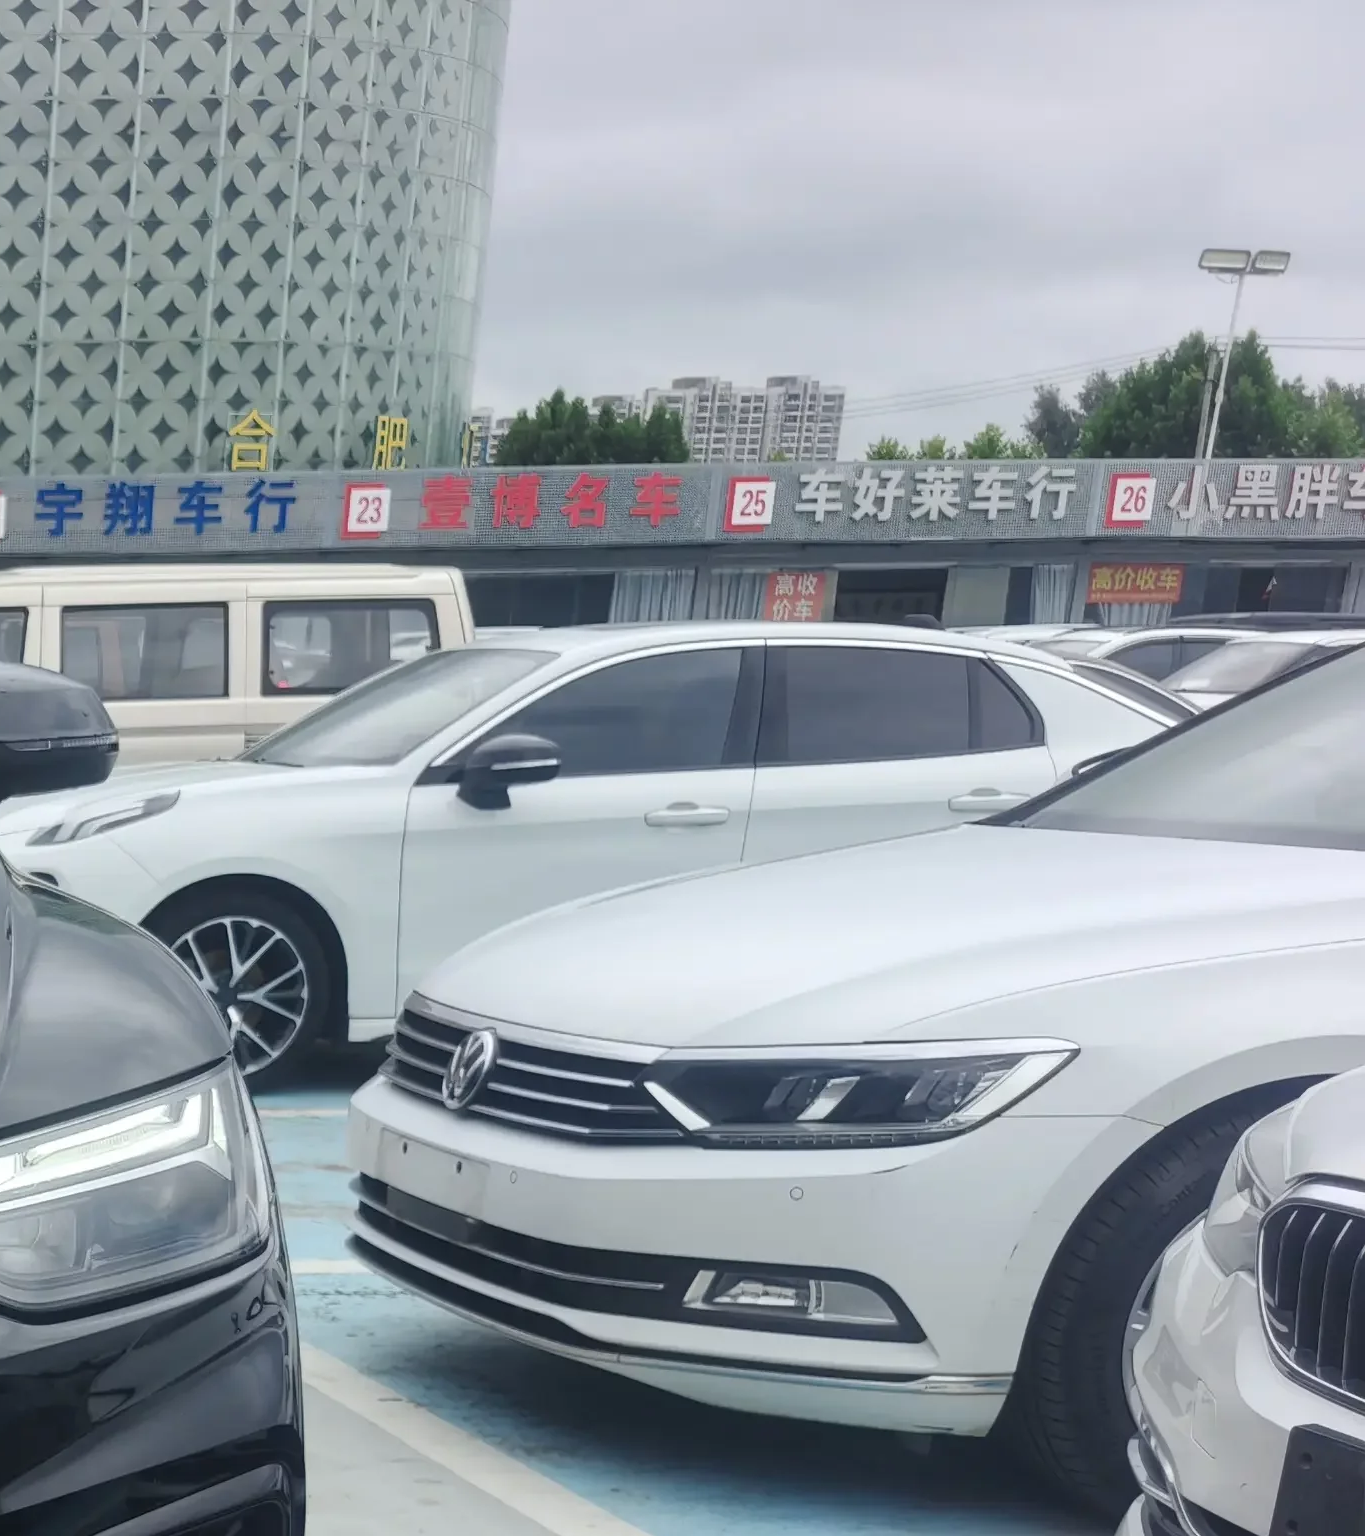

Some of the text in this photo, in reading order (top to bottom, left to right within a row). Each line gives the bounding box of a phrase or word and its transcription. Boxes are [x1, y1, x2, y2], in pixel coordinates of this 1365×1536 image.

[34, 478, 297, 537] 宇翔车行
[418, 472, 683, 530] 壹博名车
[740, 489, 767, 517] 25
[795, 466, 1076, 522] 车好莱车行
[1120, 485, 1147, 513] 26
[356, 496, 383, 524] 23
[1091, 565, 1181, 592] 高价收车
